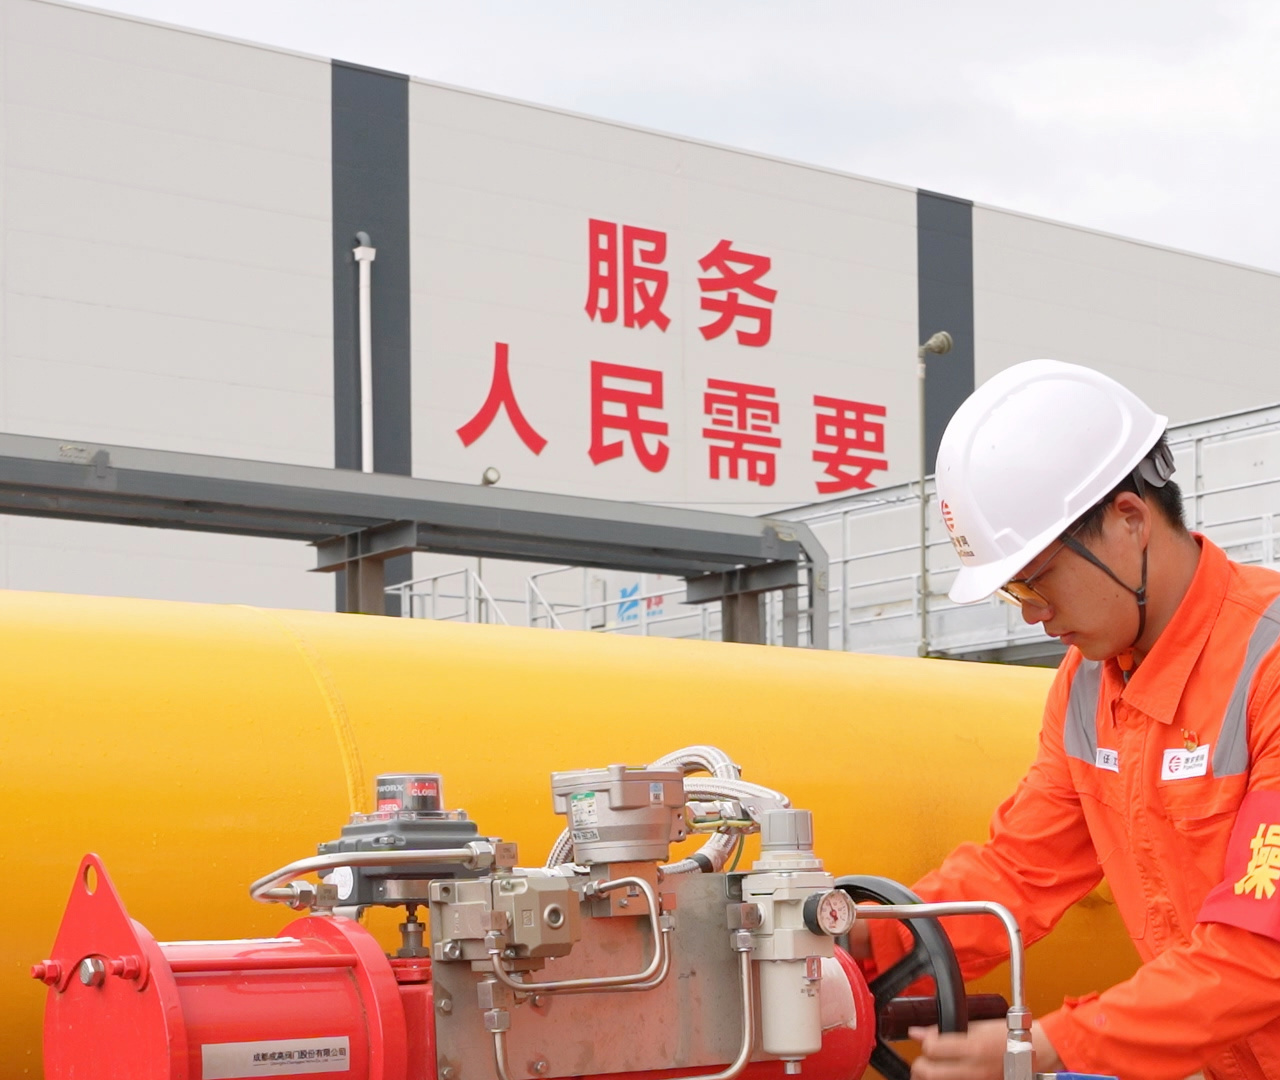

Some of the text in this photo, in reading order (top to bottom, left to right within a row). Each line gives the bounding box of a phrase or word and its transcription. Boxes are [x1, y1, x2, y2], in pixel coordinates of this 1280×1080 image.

[584, 218, 778, 348] 服务
[456, 341, 889, 494] 人民需要
